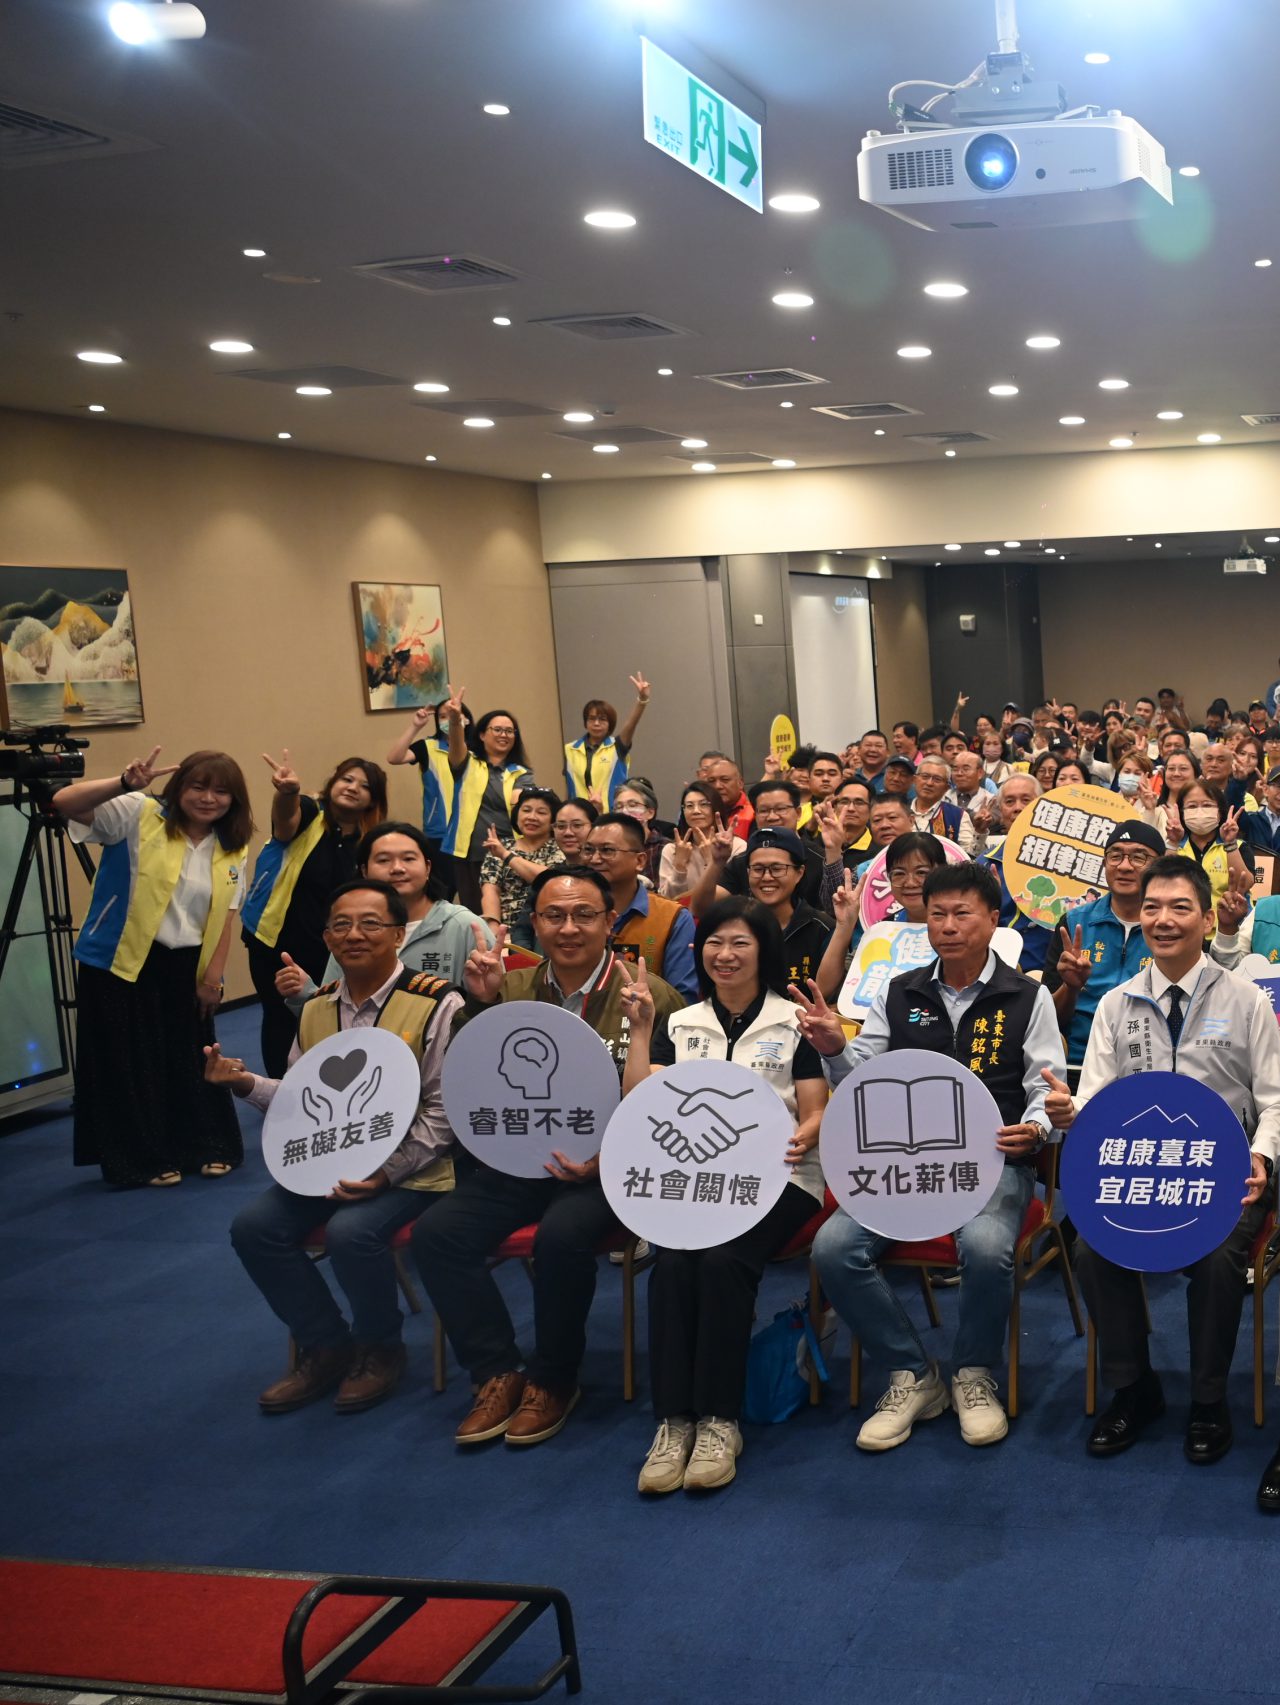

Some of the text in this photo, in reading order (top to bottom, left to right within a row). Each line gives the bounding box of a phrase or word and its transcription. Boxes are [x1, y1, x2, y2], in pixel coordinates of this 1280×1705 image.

[656, 133, 680, 156] EXIT
[1031, 798, 1118, 850] 健康飲
[969, 1018, 990, 1073] 陳銘風
[988, 1009, 1006, 1065] 臺東市長
[283, 1111, 395, 1167] 無礙友善
[469, 1106, 596, 1136] 睿智不老
[1098, 1137, 1217, 1168] 健康臺東
[622, 1165, 762, 1207] 社會關懷
[848, 1160, 981, 1197] 文化薪傳
[1094, 1176, 1216, 1207] 宜居城市
